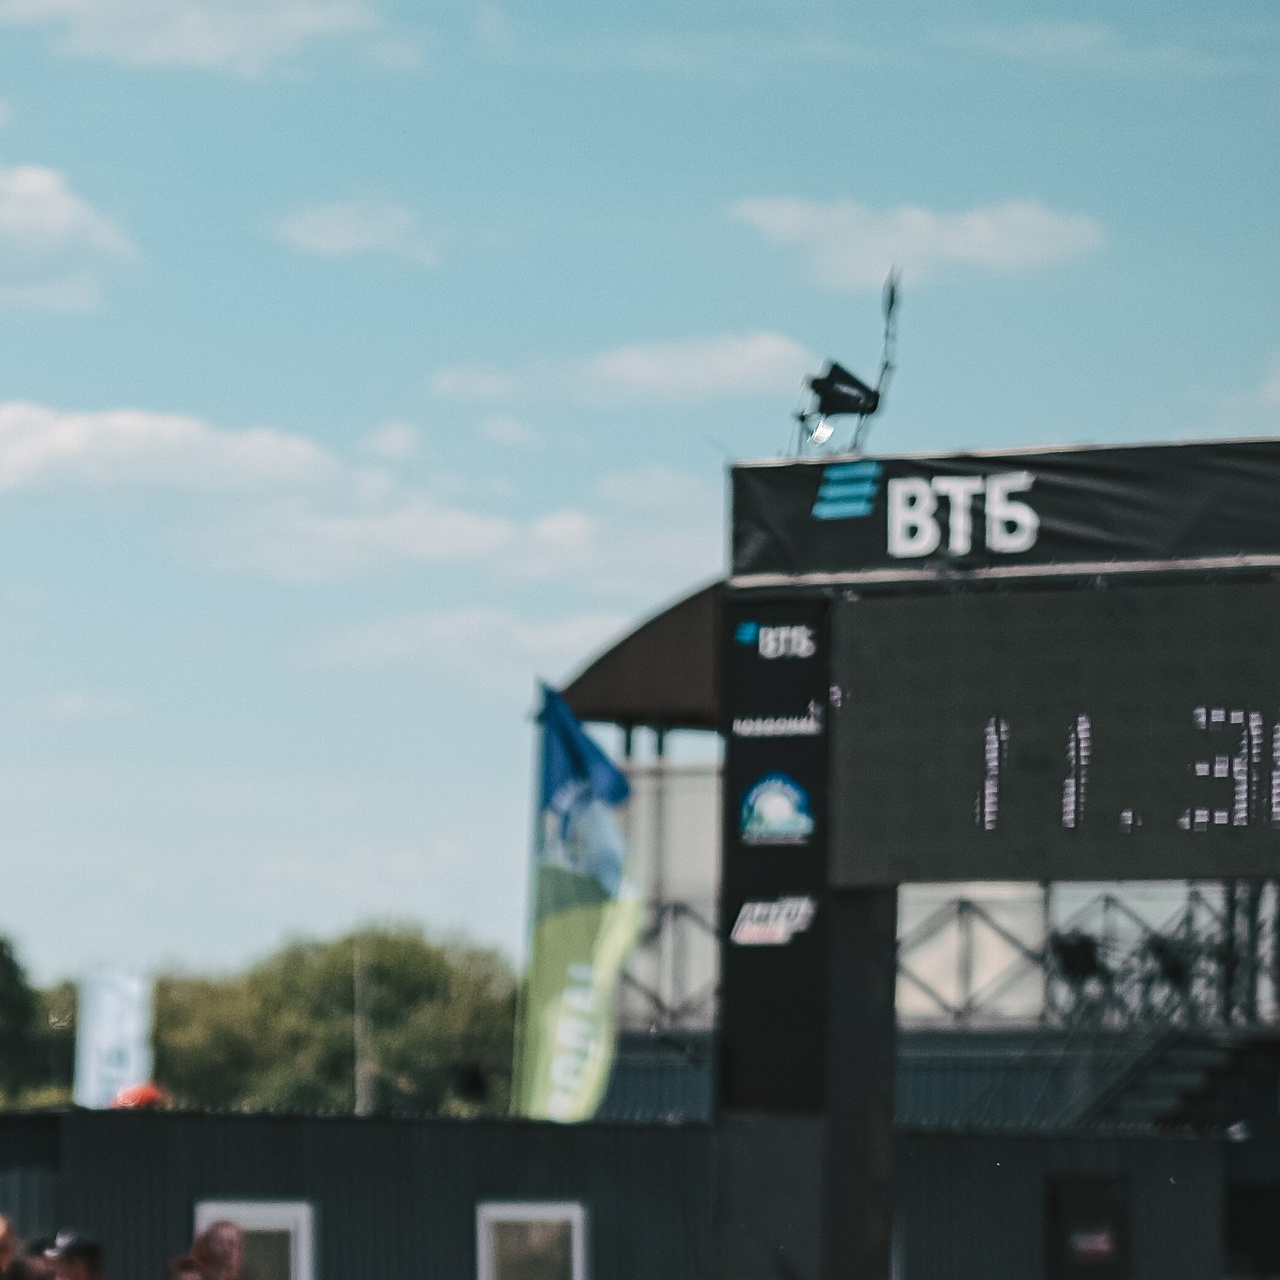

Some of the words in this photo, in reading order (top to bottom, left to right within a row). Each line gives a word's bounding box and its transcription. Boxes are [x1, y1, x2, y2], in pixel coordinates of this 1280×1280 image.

[887, 470, 1040, 558] ВТБ
[759, 626, 816, 659] ВТБ
[975, 704, 1280, 830] 11.3
